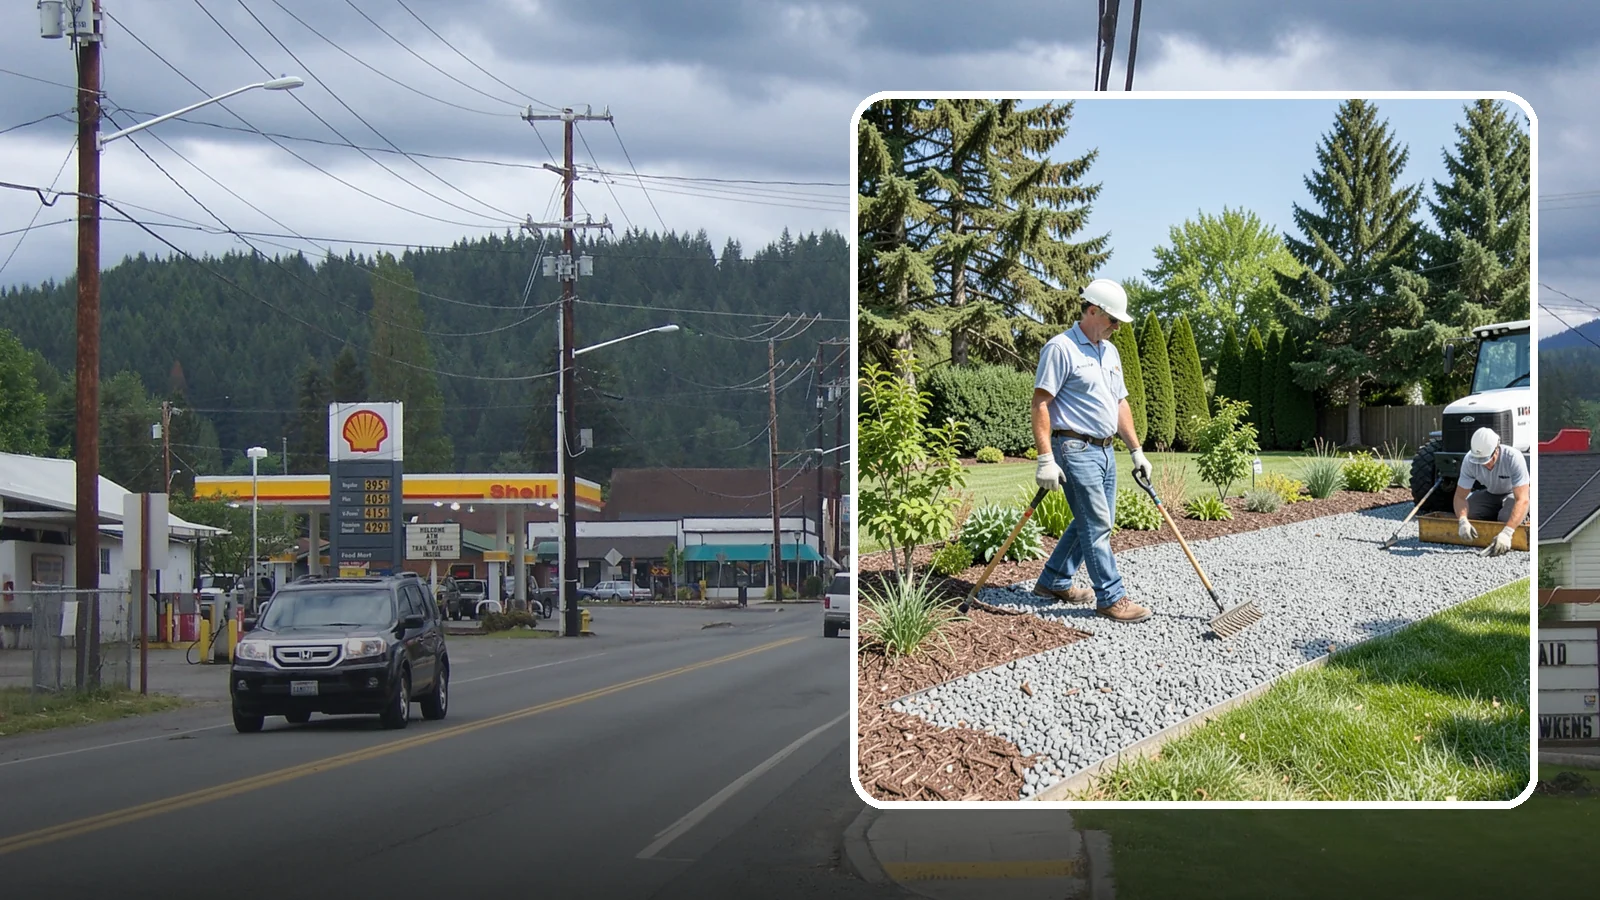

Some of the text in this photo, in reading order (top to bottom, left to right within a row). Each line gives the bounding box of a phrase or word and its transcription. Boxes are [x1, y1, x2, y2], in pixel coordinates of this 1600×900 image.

[366, 480, 384, 490] 395
[490, 484, 547, 499] Shell
[366, 494, 384, 504] 405
[366, 508, 384, 518] 415
[366, 522, 384, 532] 429
[1538, 642, 1566, 666] AID
[1539, 716, 1592, 739] WKENS
